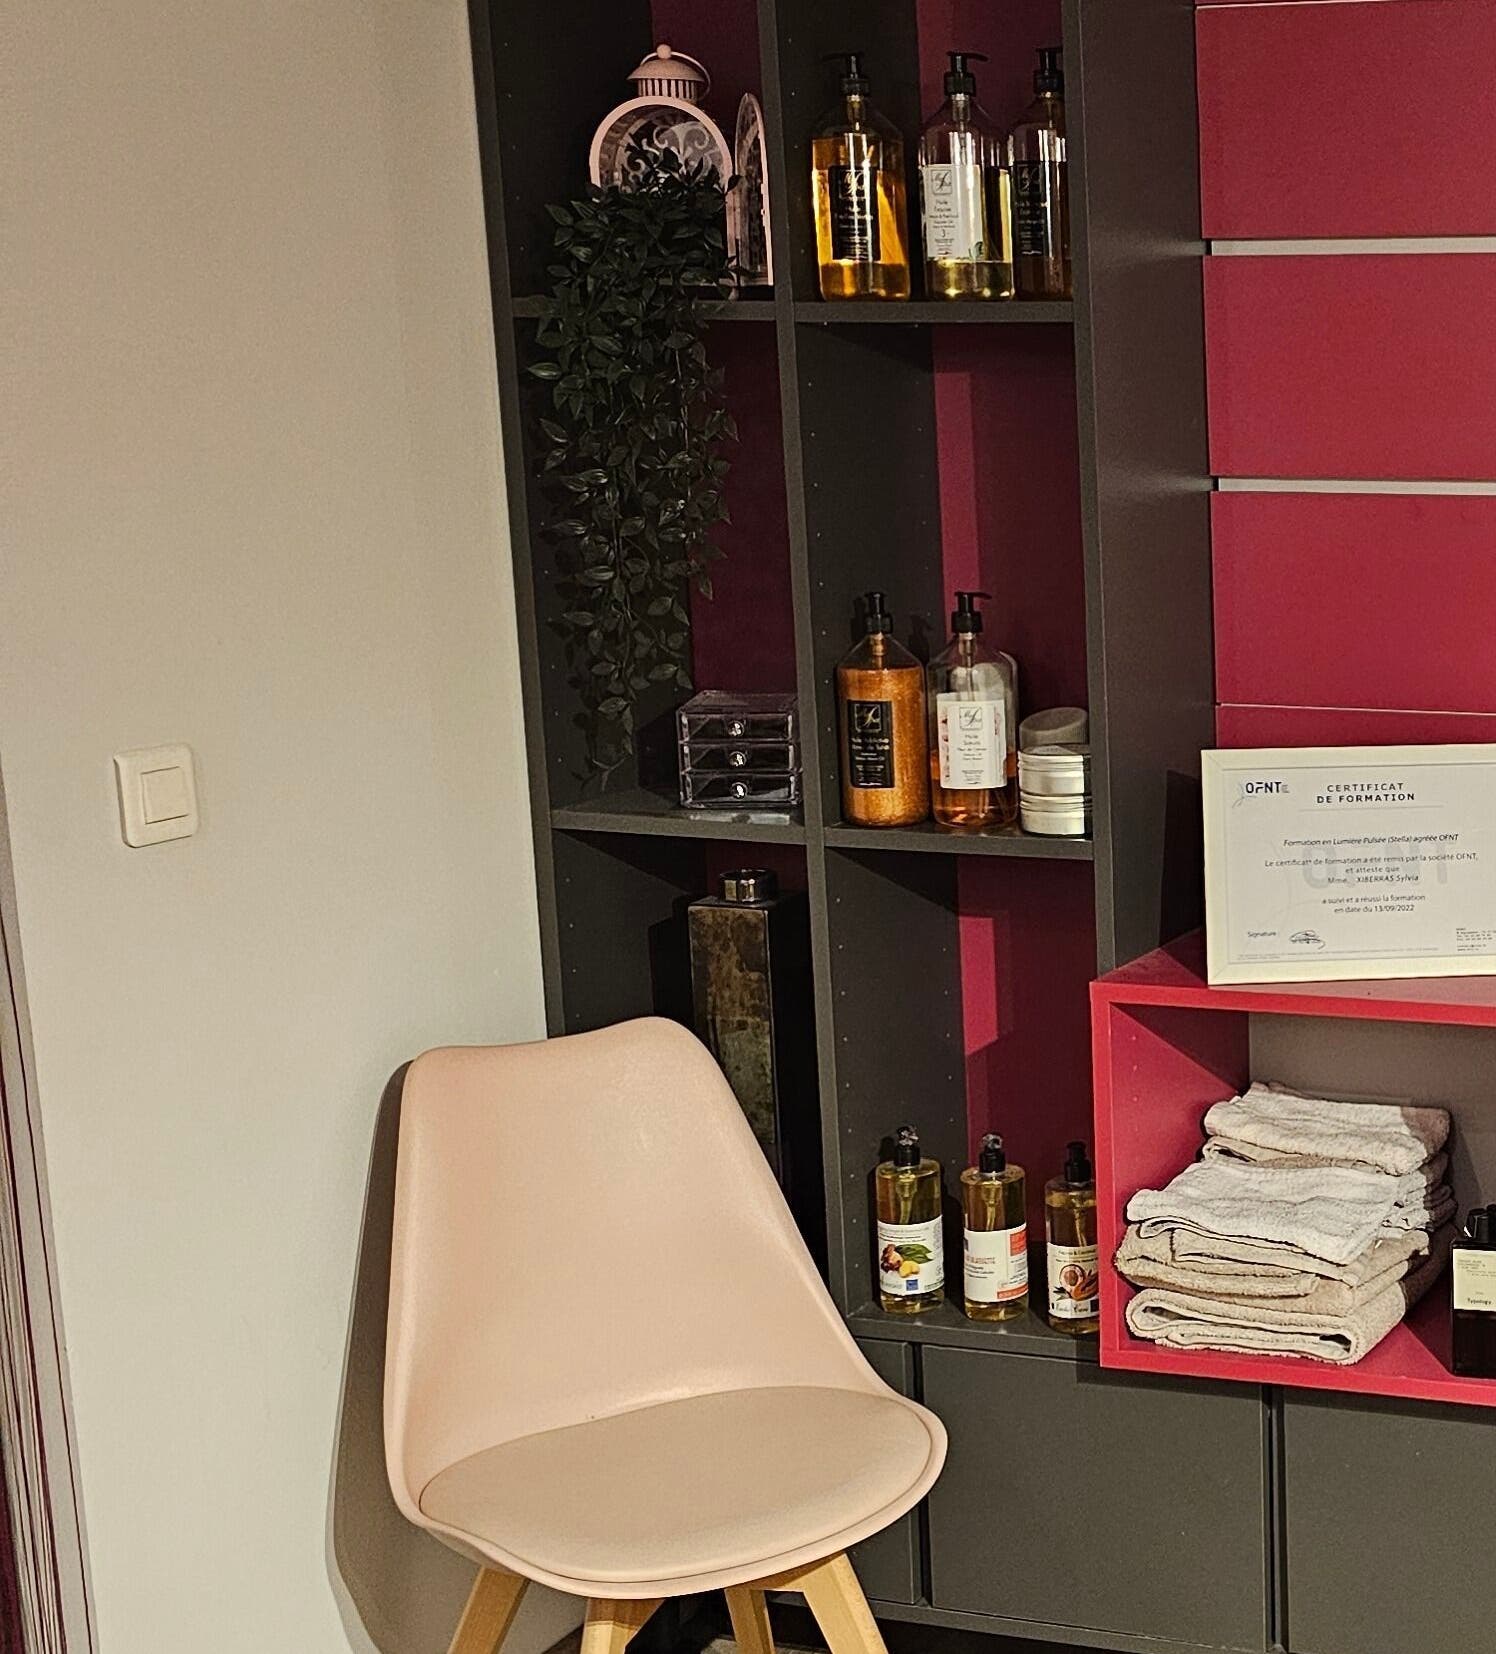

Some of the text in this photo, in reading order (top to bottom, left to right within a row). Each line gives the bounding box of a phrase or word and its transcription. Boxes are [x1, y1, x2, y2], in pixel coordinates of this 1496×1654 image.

[1327, 783, 1404, 793] CERTIFICAT
[1316, 793, 1415, 804] DE FORMATION
[1439, 833, 1459, 841] OFNT
[1324, 857, 1362, 865] formation
[1385, 866, 1400, 874] que
[1395, 874, 1419, 883] Sylvia
[1382, 894, 1389, 902] la
[1390, 893, 1426, 902] formation
[1345, 905, 1361, 913] date
[1363, 905, 1373, 913] du
[1374, 904, 1415, 913] 13/09/2022
